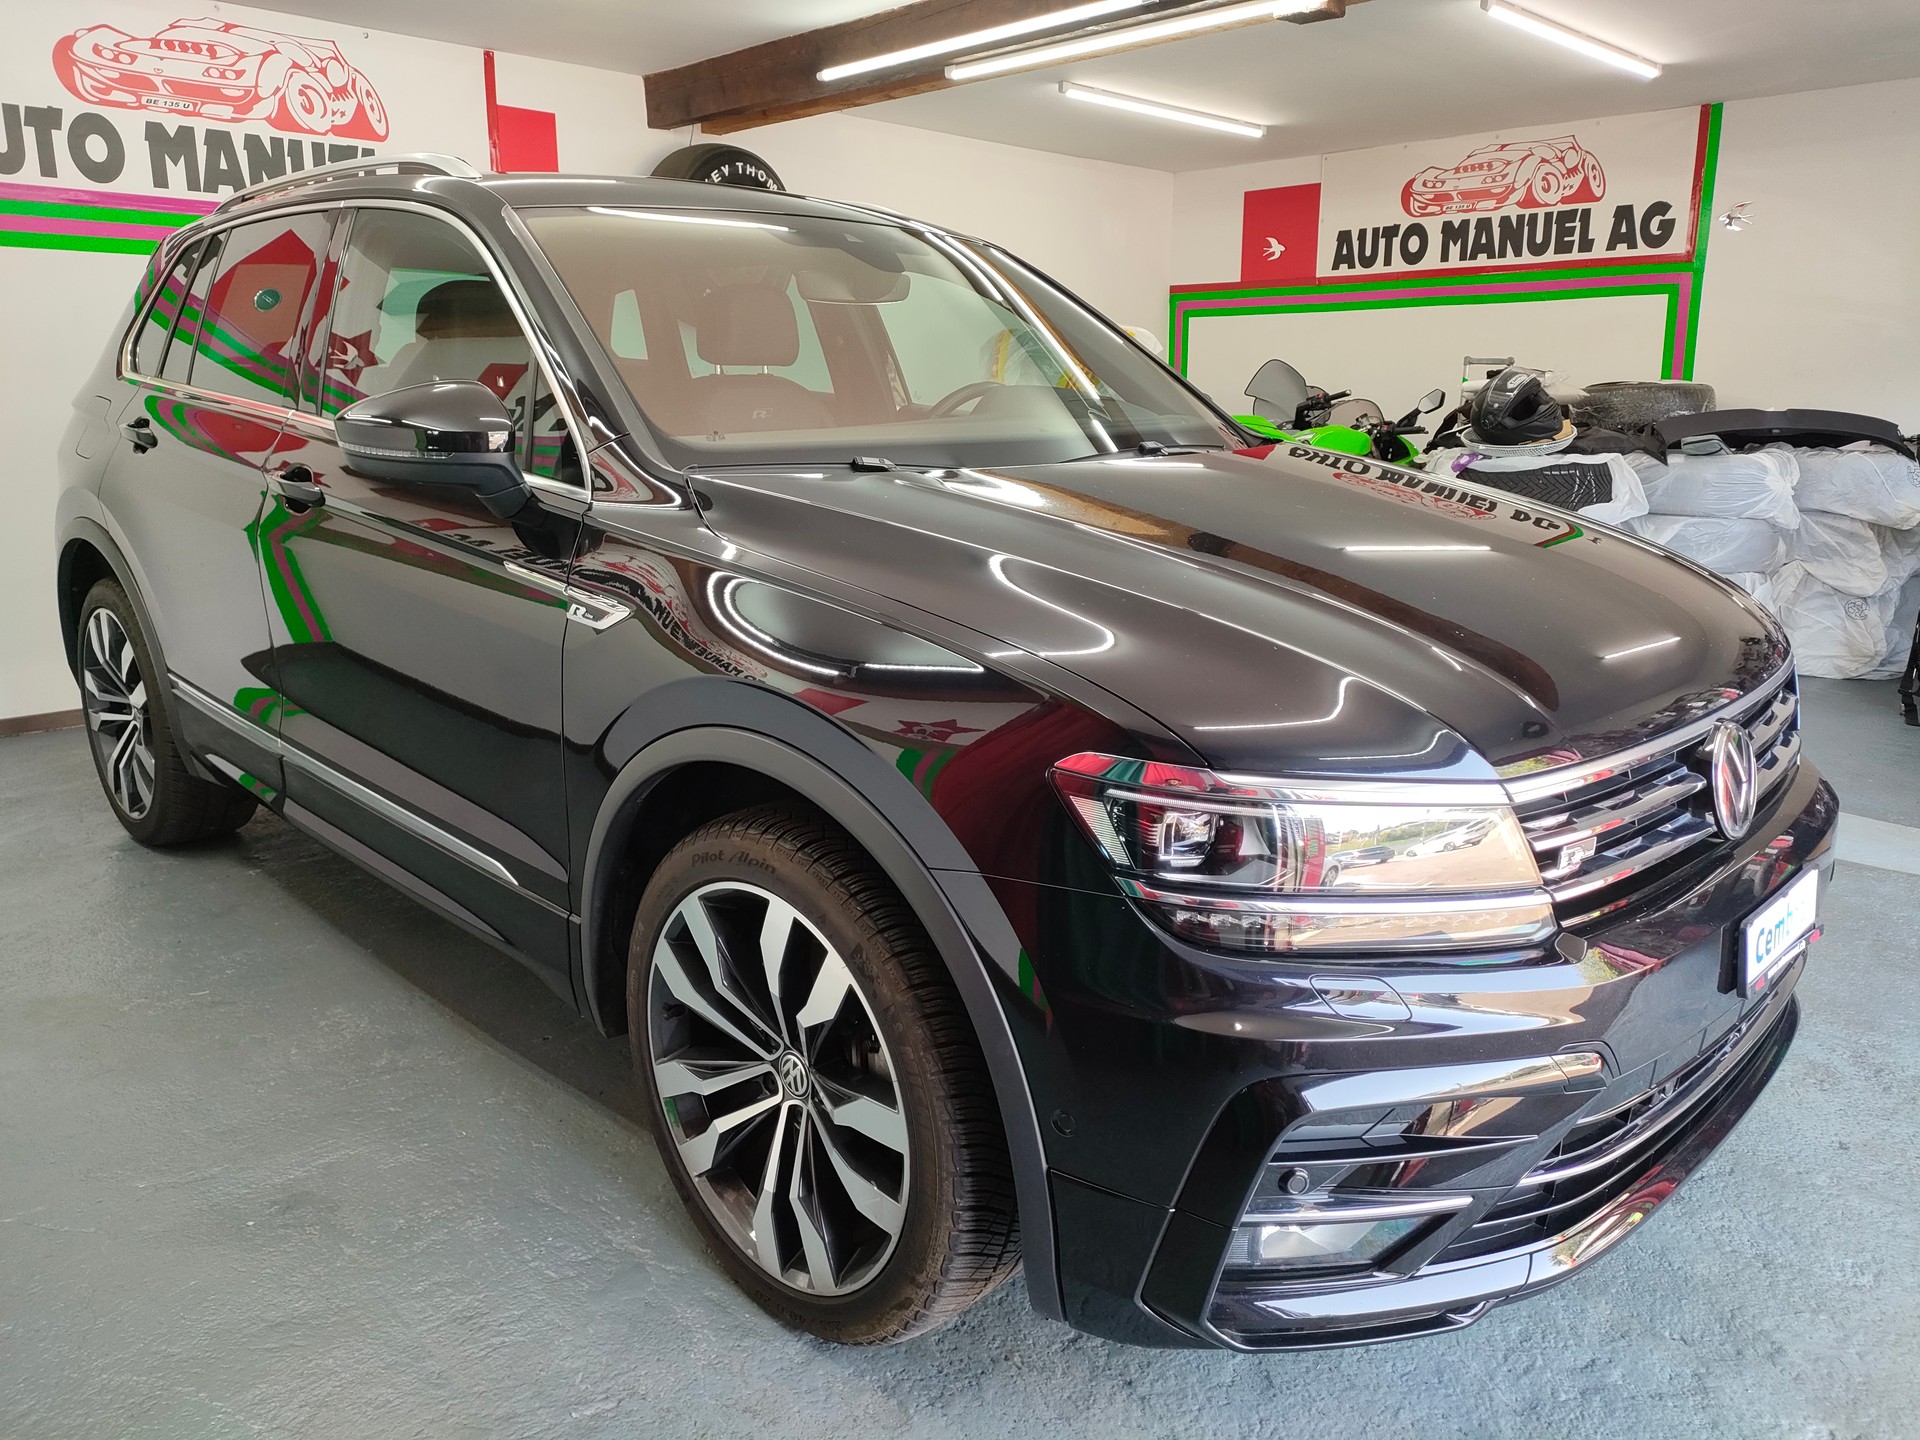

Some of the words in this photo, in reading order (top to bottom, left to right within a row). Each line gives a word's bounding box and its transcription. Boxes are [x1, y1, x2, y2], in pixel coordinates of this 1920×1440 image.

[163, 100, 180, 108] 135
[0, 103, 125, 184] UTO
[735, 162, 778, 191] THOM
[1331, 223, 1429, 271] AUTO
[1440, 207, 1594, 262] MANUEL
[1606, 200, 1676, 251] AG
